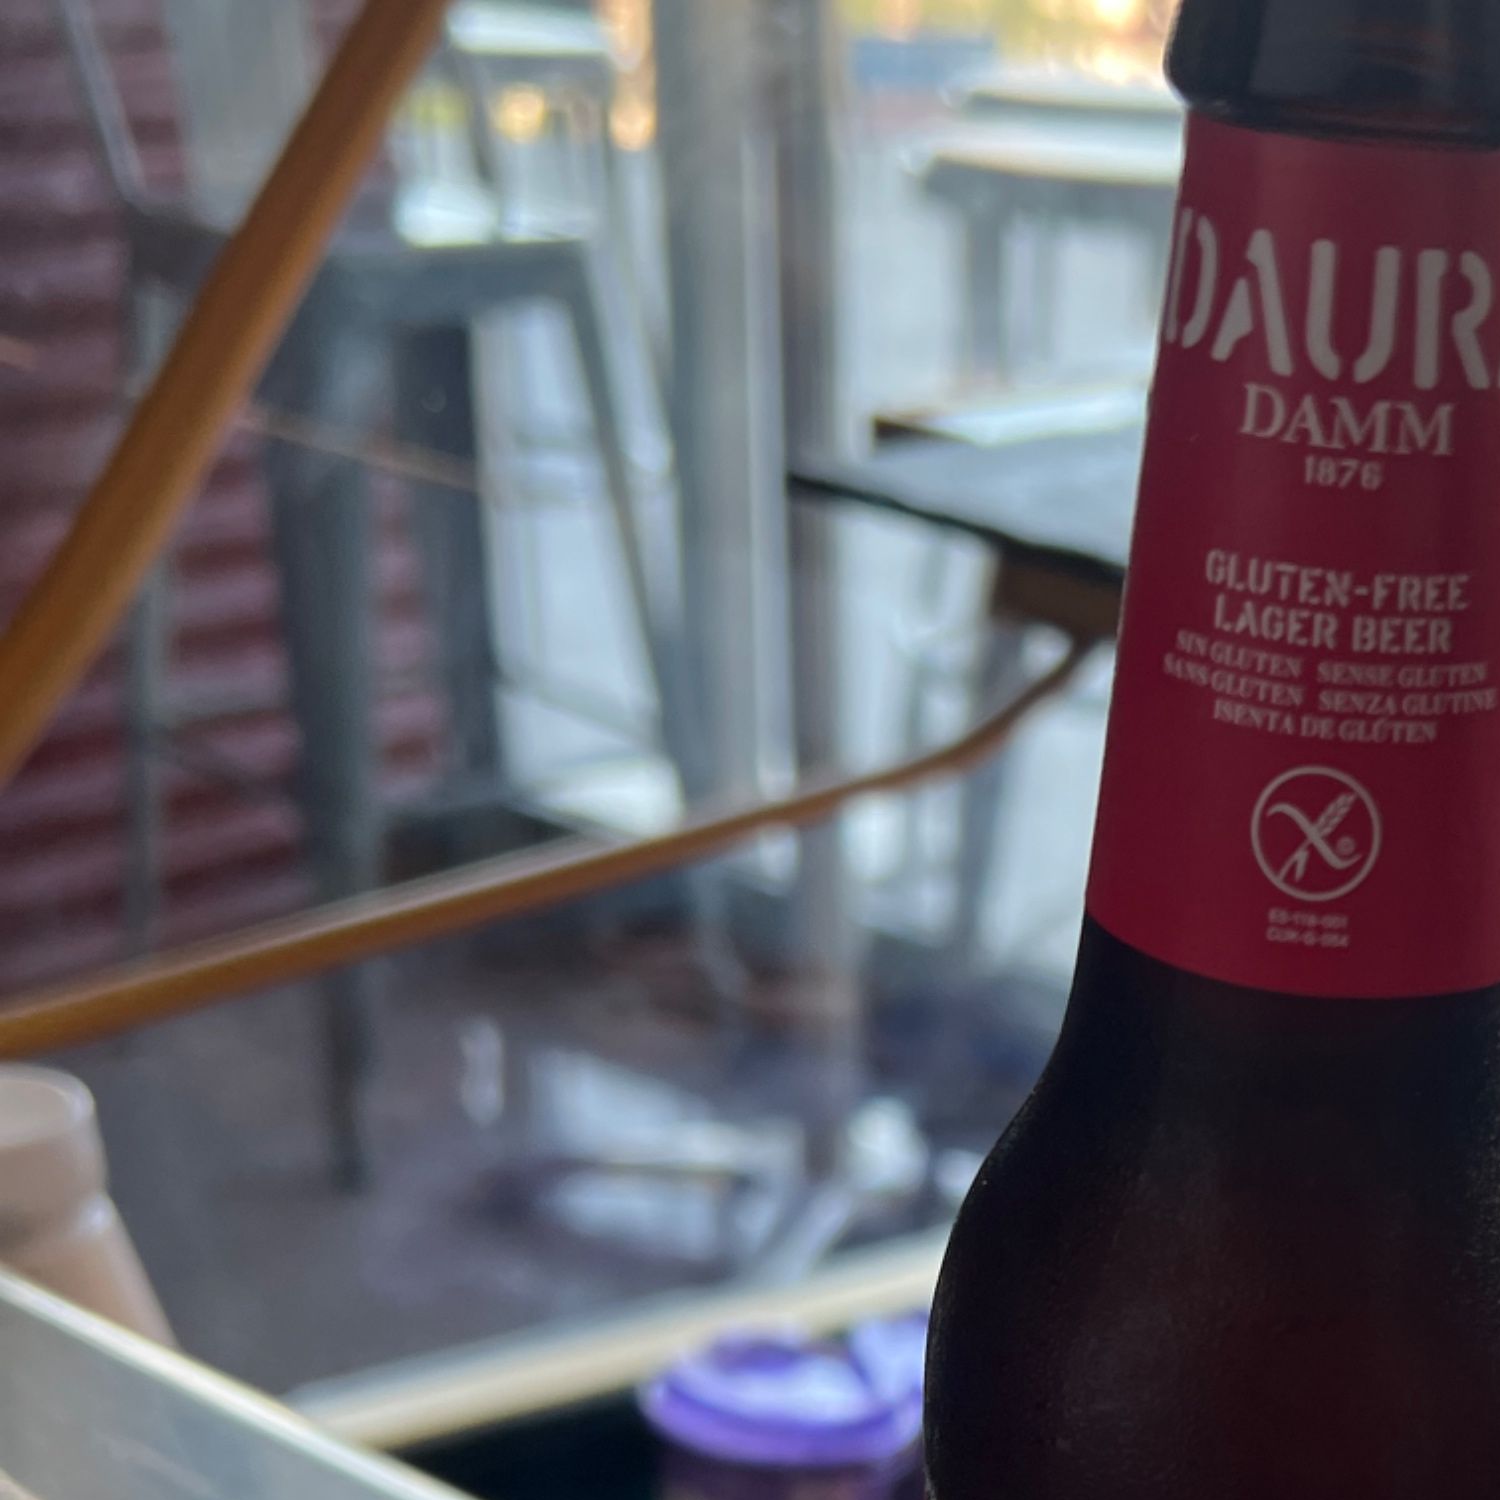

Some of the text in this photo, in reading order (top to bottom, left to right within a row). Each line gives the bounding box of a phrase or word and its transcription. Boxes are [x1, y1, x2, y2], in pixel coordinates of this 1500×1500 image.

[1240, 382, 1456, 456] DAMM
[1303, 454, 1383, 491] 1876
[1205, 549, 1470, 612] GLUTEN-FREE
[1214, 594, 1453, 655] LAGER BEER
[1176, 630, 1208, 657] SIN
[1209, 641, 1303, 678] GLUTEN
[1398, 661, 1488, 688] GLUTEN
[1211, 669, 1304, 706] GLUTEN
[1300, 714, 1334, 740] DE
